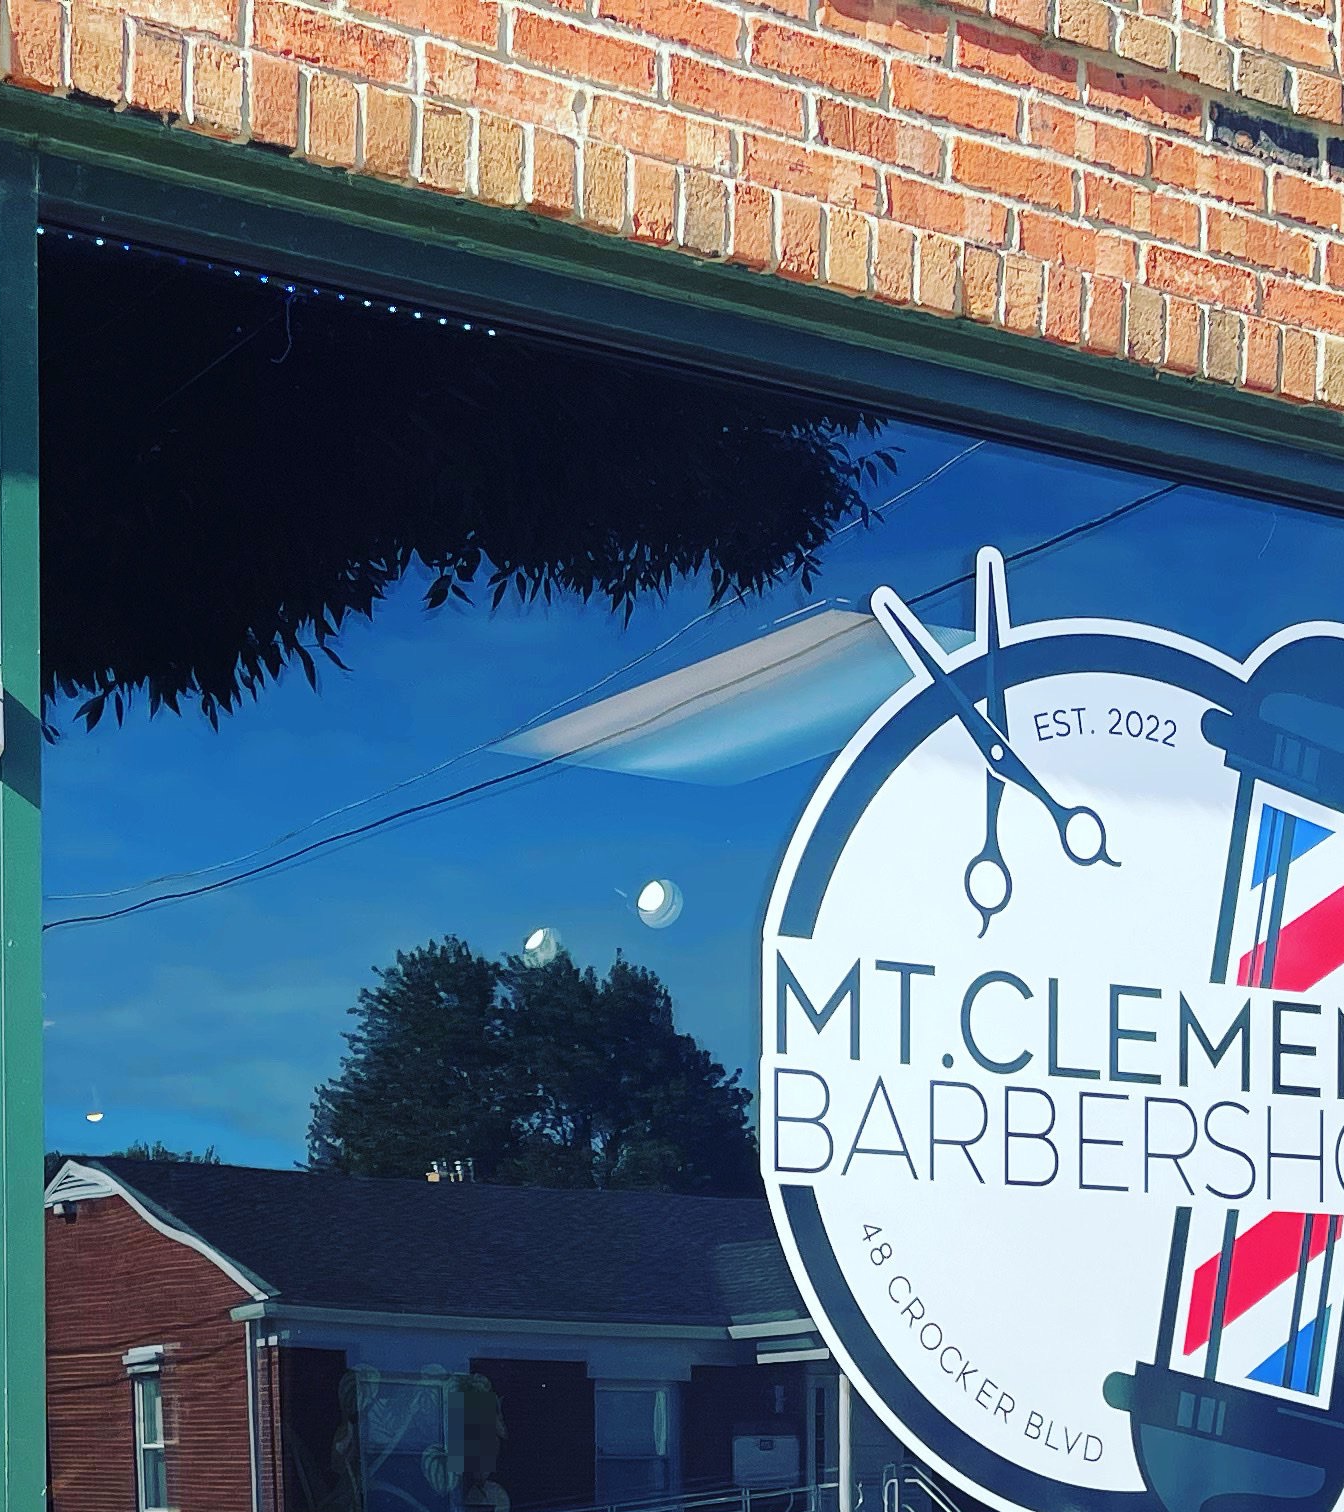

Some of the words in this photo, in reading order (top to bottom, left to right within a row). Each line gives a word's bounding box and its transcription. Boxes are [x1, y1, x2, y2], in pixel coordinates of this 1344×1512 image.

[1033, 708, 1096, 742] EST.
[1108, 708, 1178, 747] 2022
[861, 1223, 893, 1266] 48
[888, 1275, 1016, 1424] CROCKER
[1023, 1410, 1104, 1462] BLVD
